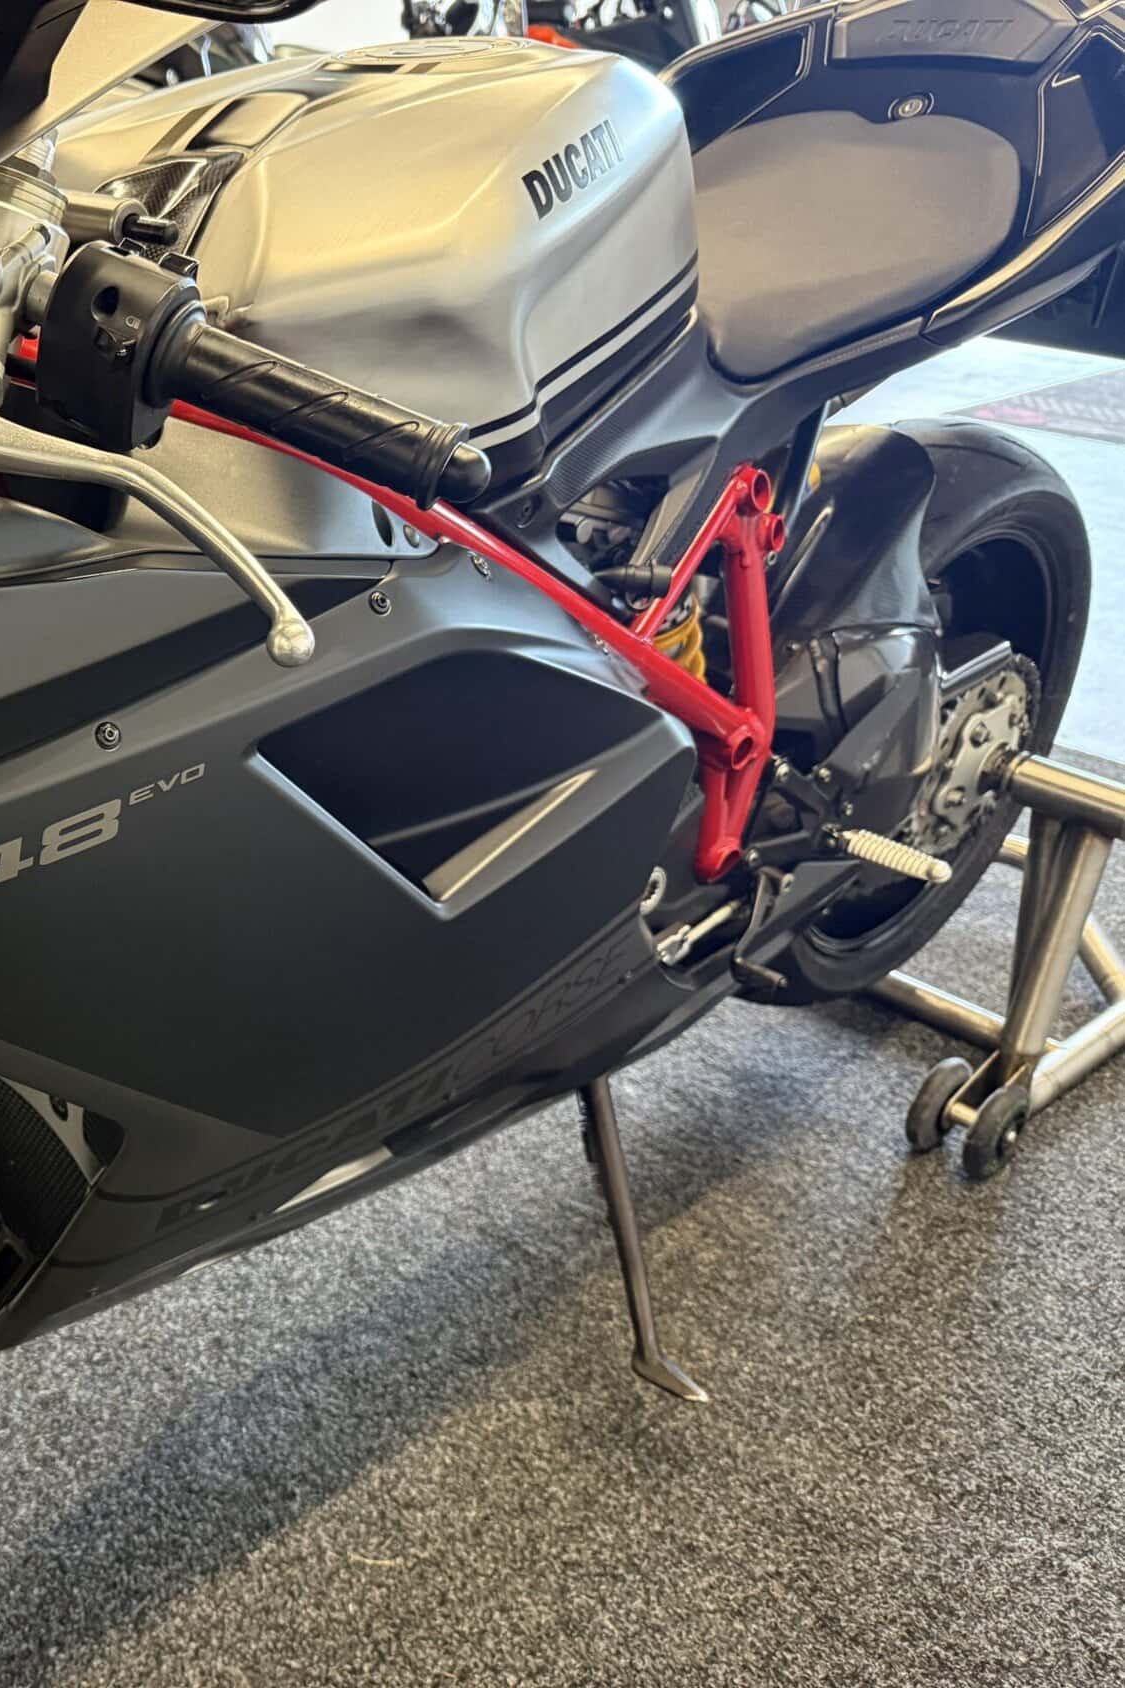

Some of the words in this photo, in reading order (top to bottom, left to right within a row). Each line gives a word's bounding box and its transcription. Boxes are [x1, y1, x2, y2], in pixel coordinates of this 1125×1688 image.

[878, 18, 1014, 42] DUCATI
[521, 119, 624, 220] DUCATI
[129, 763, 205, 806] EVO
